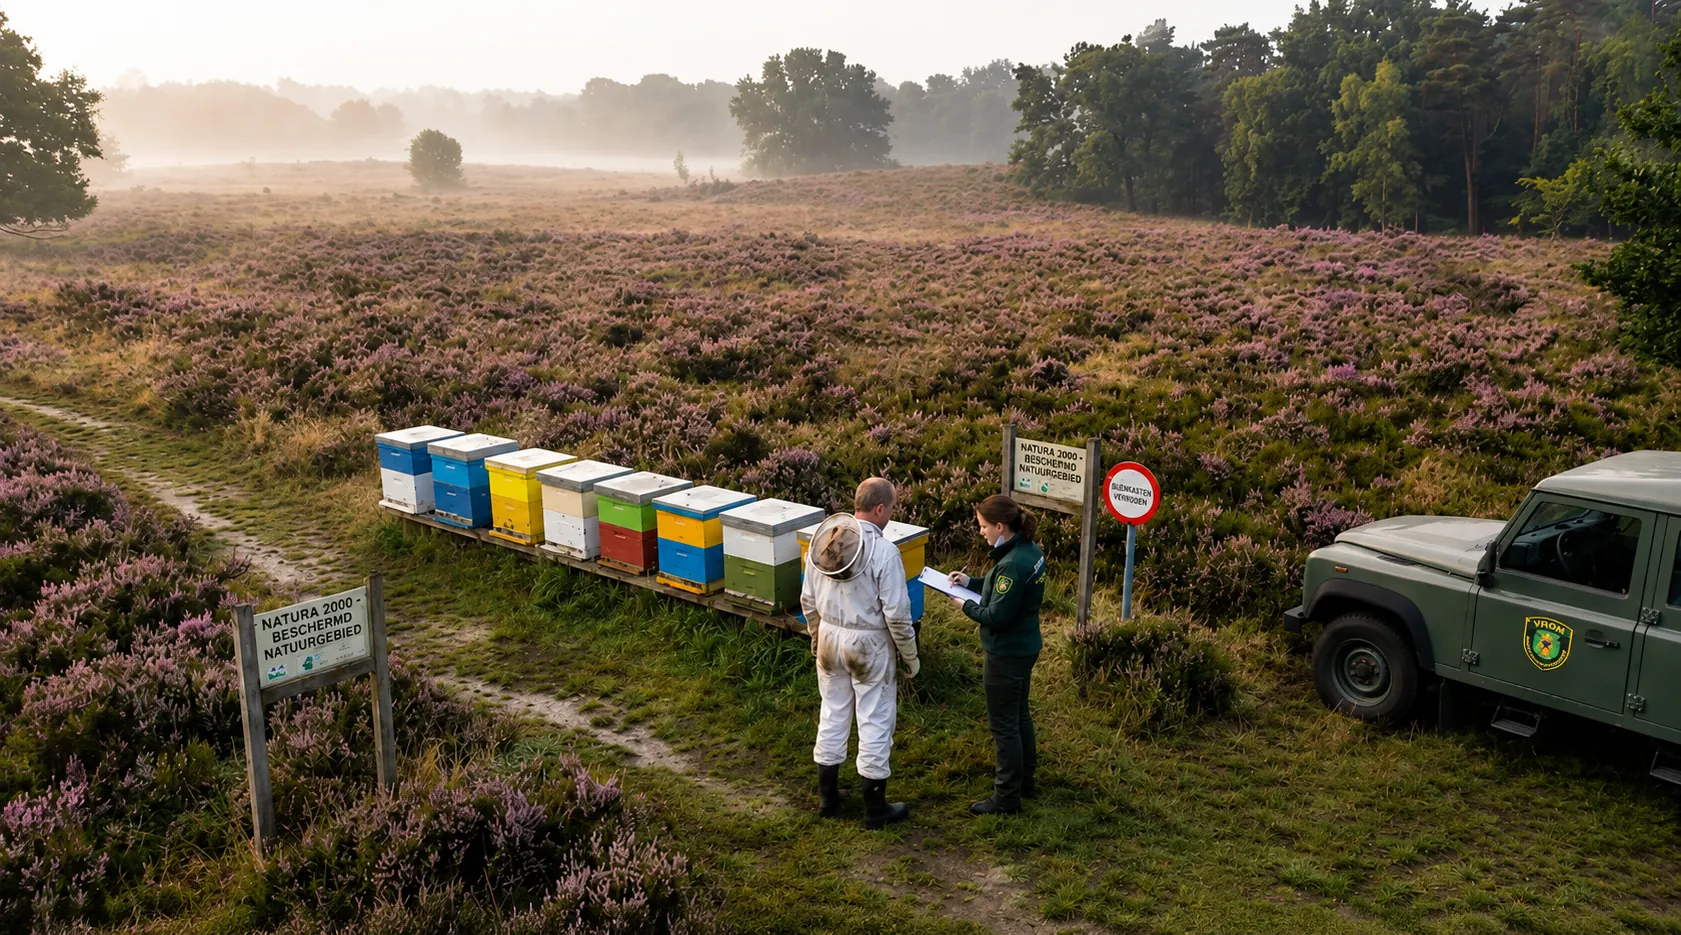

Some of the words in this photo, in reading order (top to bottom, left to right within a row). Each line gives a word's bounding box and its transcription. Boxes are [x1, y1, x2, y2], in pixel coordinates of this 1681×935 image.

[1021, 443, 1055, 456] NATURA
[1057, 450, 1077, 460] 2000
[1019, 464, 1081, 483] NATUURGEBIED
[262, 607, 319, 631] NATURA
[323, 597, 353, 615] 2000
[272, 612, 352, 643] BESCHERMD
[1533, 620, 1565, 635] VROM
[264, 624, 362, 660] NATUURGEBIED
